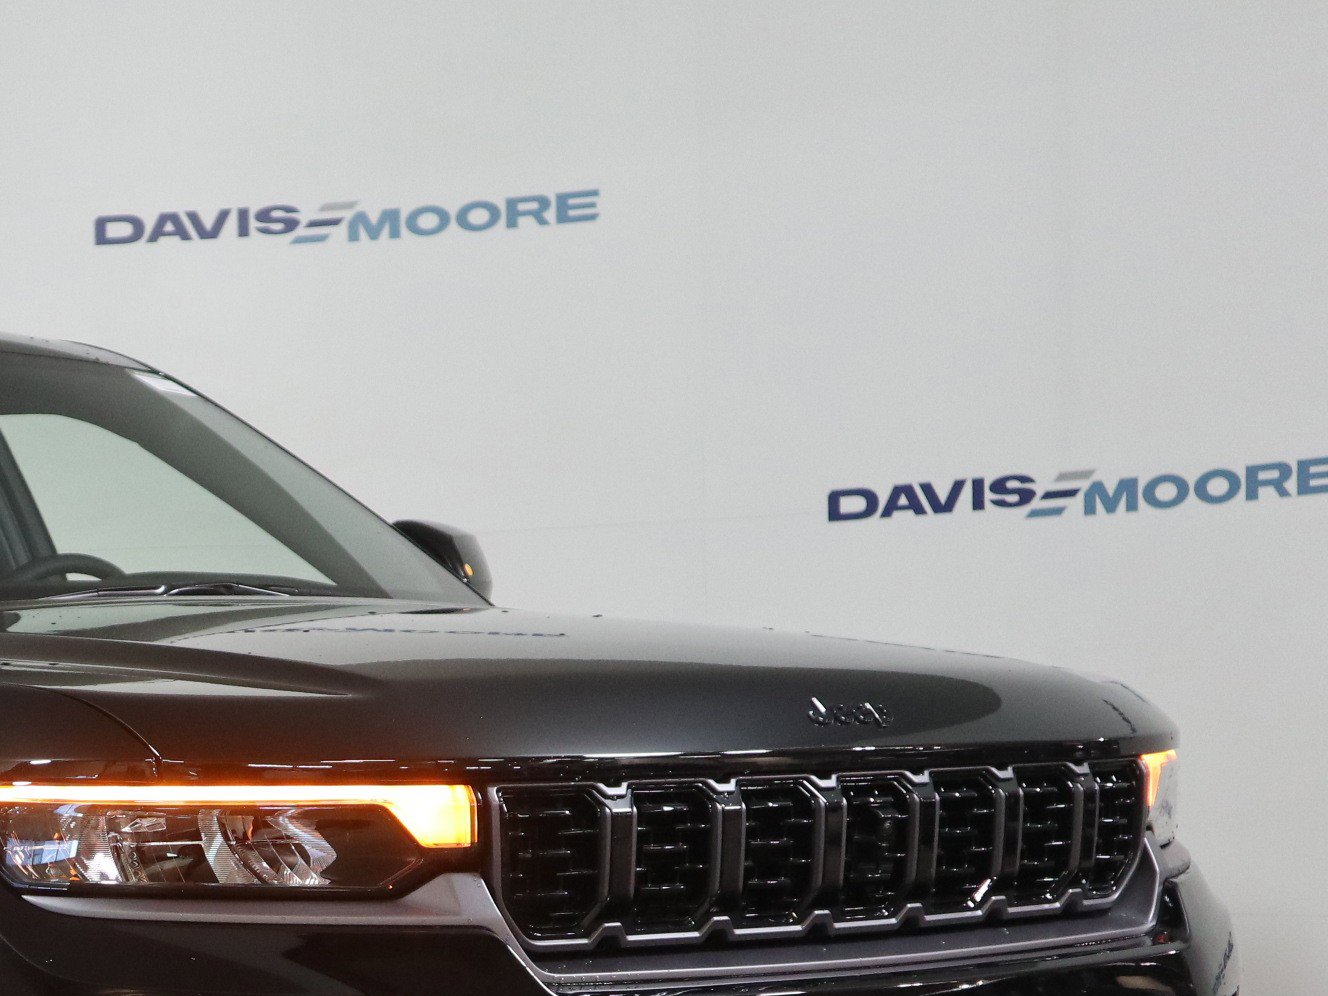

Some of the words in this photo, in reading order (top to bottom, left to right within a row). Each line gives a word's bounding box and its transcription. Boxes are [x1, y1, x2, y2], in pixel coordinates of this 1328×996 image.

[94, 204, 301, 246] DAVIS
[347, 189, 600, 243] MOORE
[827, 474, 1037, 523] DAVIS
[1083, 456, 1328, 516] MOORE
[808, 696, 894, 728] Jeep
